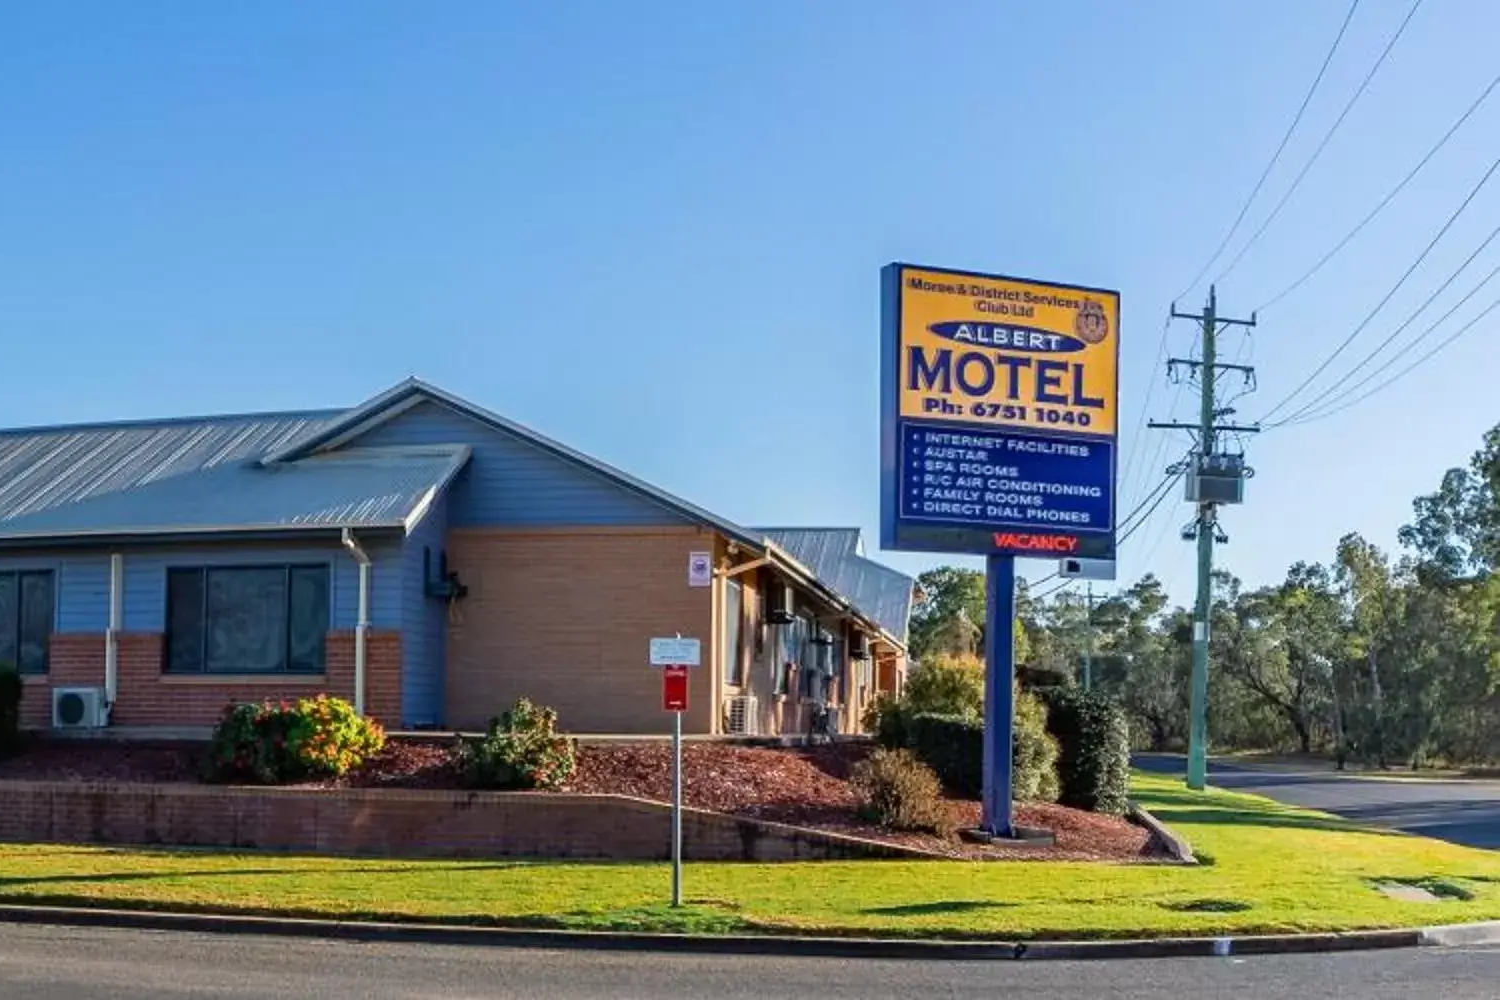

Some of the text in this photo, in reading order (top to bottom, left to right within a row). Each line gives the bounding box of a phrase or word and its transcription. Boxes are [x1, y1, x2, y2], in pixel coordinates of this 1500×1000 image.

[970, 285, 1020, 301] District
[1024, 291, 1079, 309] Services
[975, 300, 1035, 317] Club Ltd
[954, 324, 1063, 350] ALBERT
[906, 346, 1105, 409] MOTEL
[924, 398, 1091, 426] Ph: 6751 1040
[924, 447, 988, 461] AUSTAR
[925, 432, 1090, 457] INTERNET FACILITIES
[924, 460, 1019, 477] SPA ROOMS
[924, 474, 1102, 497] R/C AIR CONDITIONING
[924, 488, 1044, 505] FAMILY ROOMS
[924, 502, 1091, 523] DIRECT DIAL PHONES
[994, 532, 1078, 551] VACANCY
